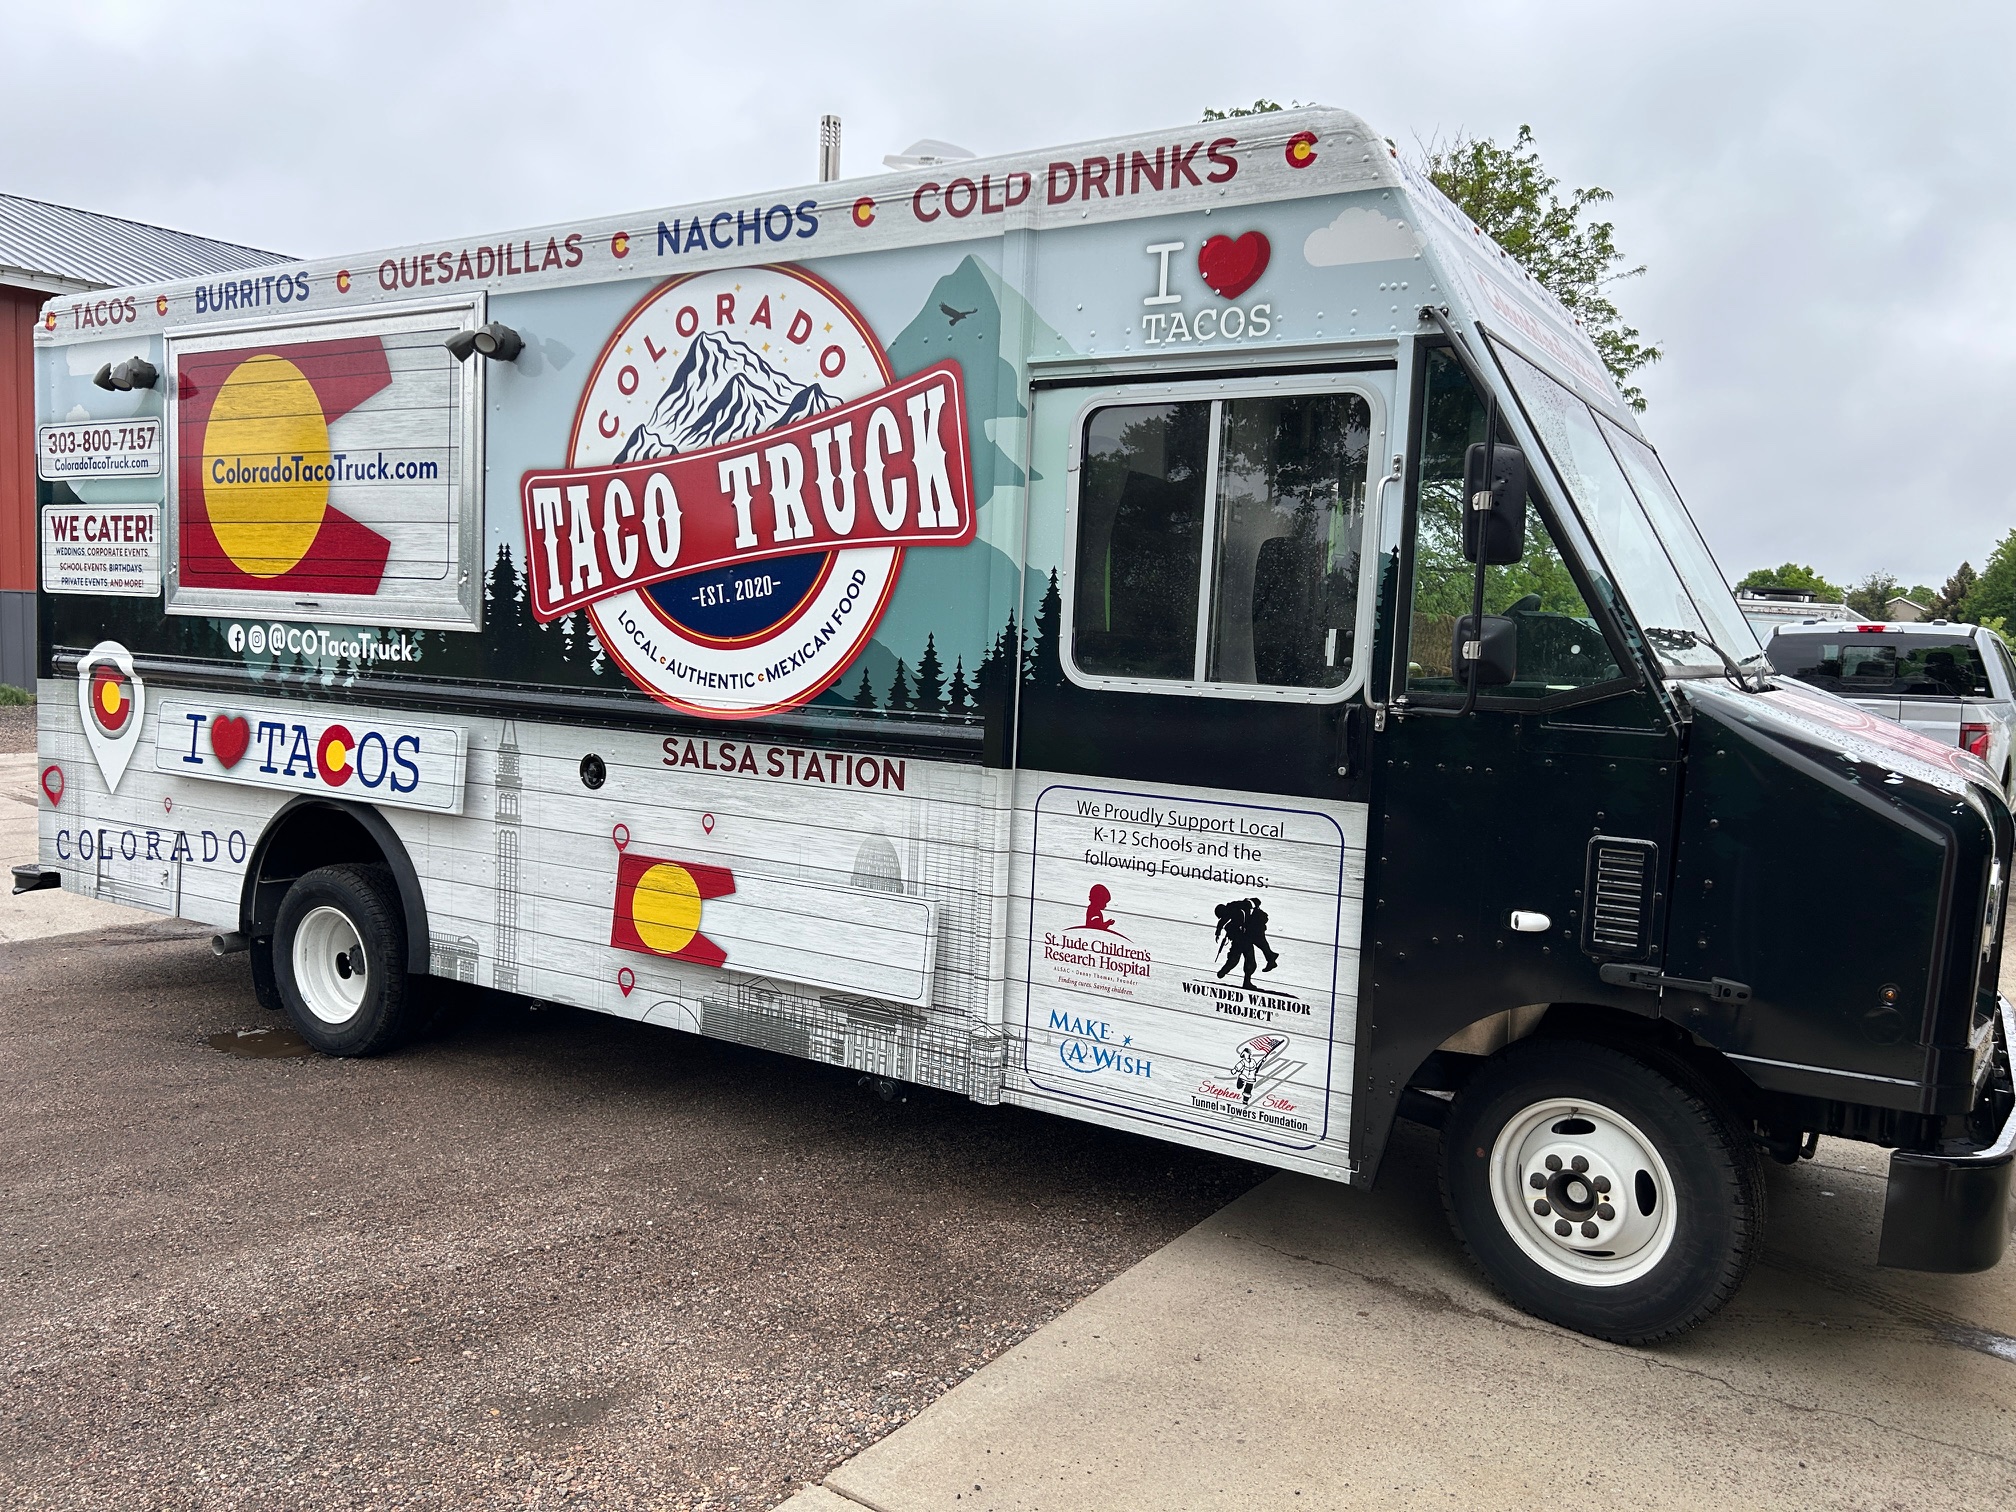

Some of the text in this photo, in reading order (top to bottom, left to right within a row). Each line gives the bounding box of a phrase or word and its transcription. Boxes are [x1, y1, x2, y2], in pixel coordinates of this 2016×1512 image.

[912, 137, 1238, 223] COLD DRINKS
[657, 200, 819, 257] NACHOS
[378, 233, 583, 291] QUESADILLAS
[1143, 241, 1186, 306] I
[195, 271, 310, 314] BURRITOS
[72, 296, 137, 329] TACOS
[1142, 304, 1271, 345] TACOS
[599, 293, 846, 439] COLORADO
[48, 426, 156, 454] 303-800-7157
[54, 455, 149, 471] ColoradoTacoTruck.com
[212, 452, 438, 485] ColoradoTacoTruck.com
[532, 385, 959, 604] TACO TRUCK
[50, 514, 154, 542] WE CATER!
[59, 562, 83, 571] SCHOOL
[87, 547, 123, 557] CORPORATE
[60, 577, 84, 586] PRIVATE
[109, 578, 124, 587] AND
[268, 622, 413, 662] @COTacoTruck
[618, 568, 867, 690] LOCAL AUTHENTIC MEXICAN FOOD
[183, 713, 421, 793] I TACOS
[662, 737, 905, 791] SALSA STATION
[1077, 800, 1284, 838] We Proudly Support Local
[56, 829, 247, 864] COLORADO
[1094, 826, 1262, 861] K-12 Schools and the
[1085, 849, 1269, 888] following Foundations:
[1044, 932, 1151, 962] St. Jude Children's
[1044, 946, 1151, 977] Research Hospital
[1058, 976, 1078, 987] Finding
[1093, 982, 1111, 993] Saving
[1182, 981, 1311, 1016] WOUNDED WARRIOR
[1191, 1095, 1219, 1111] Tunnel
[1226, 1103, 1257, 1120] Towers
[1258, 1110, 1308, 1131] Foundation
[1198, 1080, 1297, 1112] Stephen Siller
